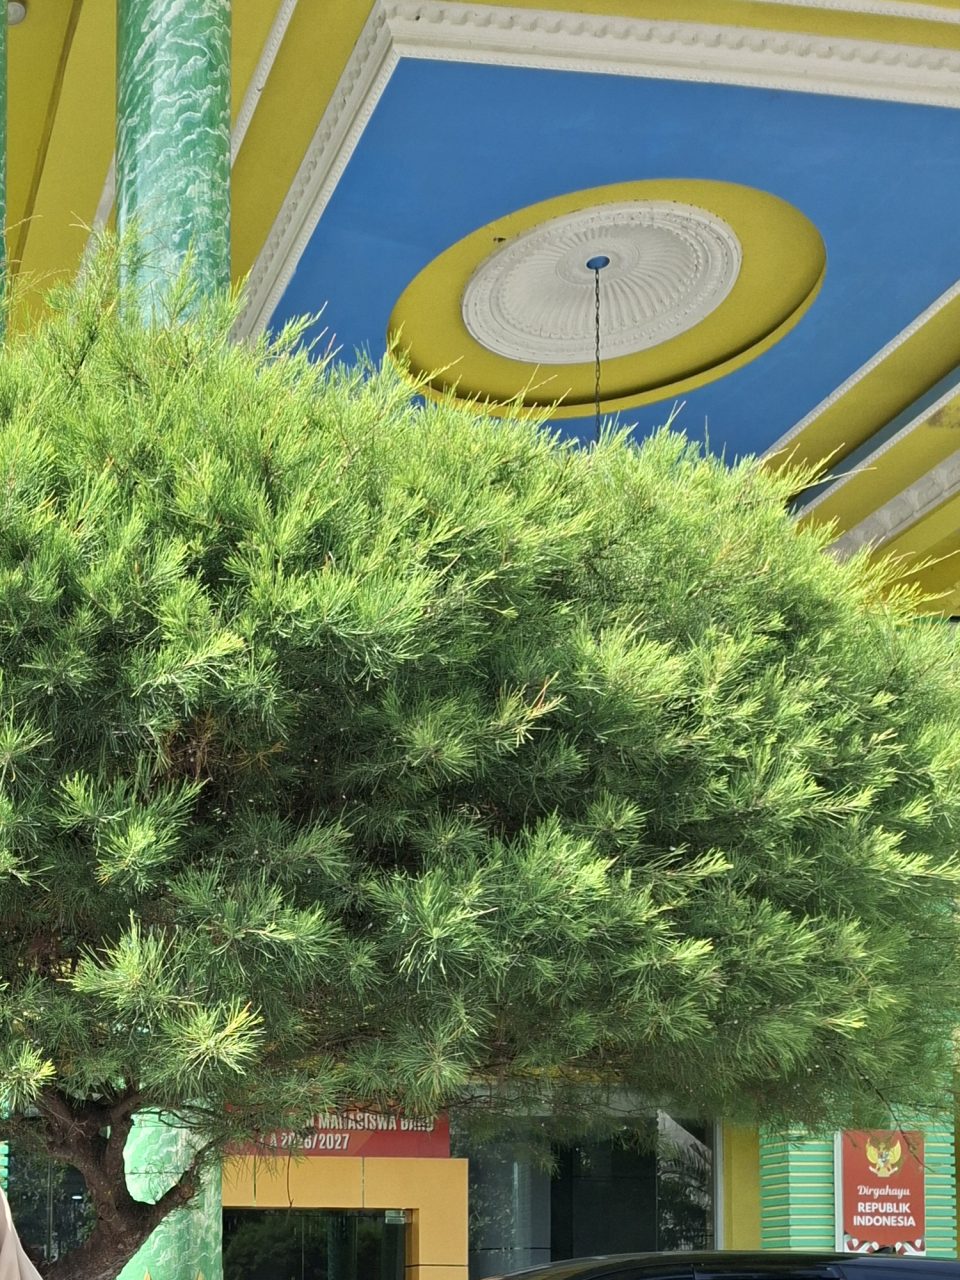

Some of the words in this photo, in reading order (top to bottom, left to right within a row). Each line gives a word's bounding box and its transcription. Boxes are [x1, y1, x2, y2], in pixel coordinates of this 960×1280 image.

[857, 1185, 911, 1199] Dirgahayu
[858, 1202, 911, 1213] REPUBLIK
[853, 1216, 916, 1226] INDONESIA
